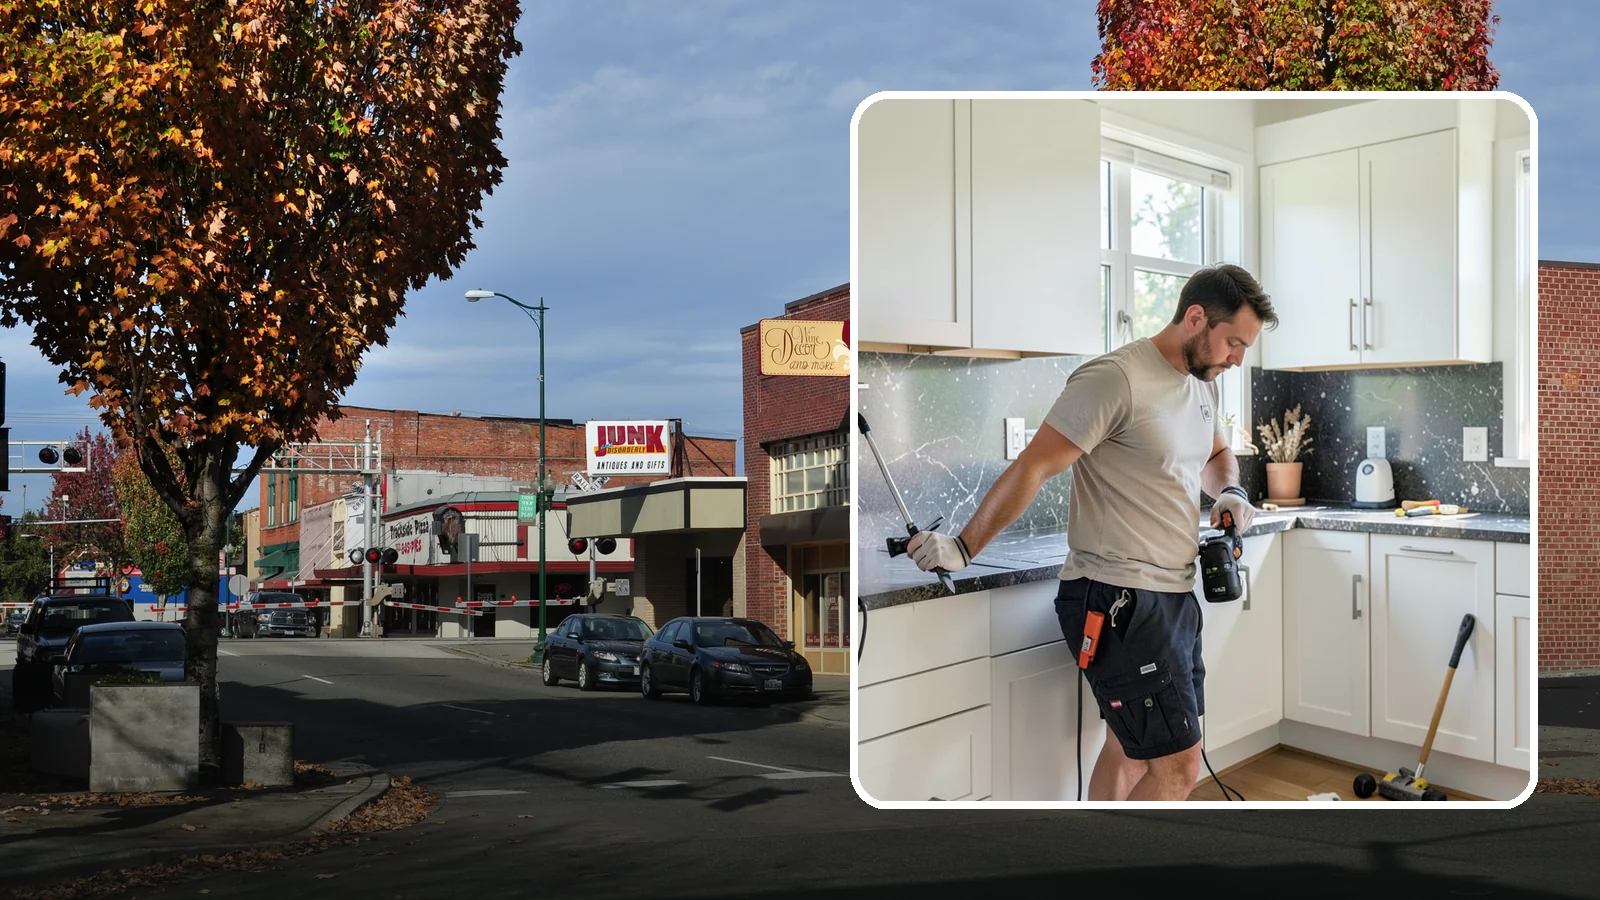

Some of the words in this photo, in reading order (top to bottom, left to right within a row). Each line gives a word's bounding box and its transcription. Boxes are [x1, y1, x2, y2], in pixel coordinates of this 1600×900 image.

[764, 328, 830, 365] Decor
[595, 425, 666, 457] JUNK
[597, 461, 628, 470] ANTIQUES
[631, 461, 644, 470] AND
[647, 460, 665, 469] GIFTS
[573, 474, 588, 490] RAIL
[590, 476, 608, 492] SING
[352, 498, 364, 510] CRO
[390, 521, 412, 539] Trackside
[415, 520, 429, 534] Pizza
